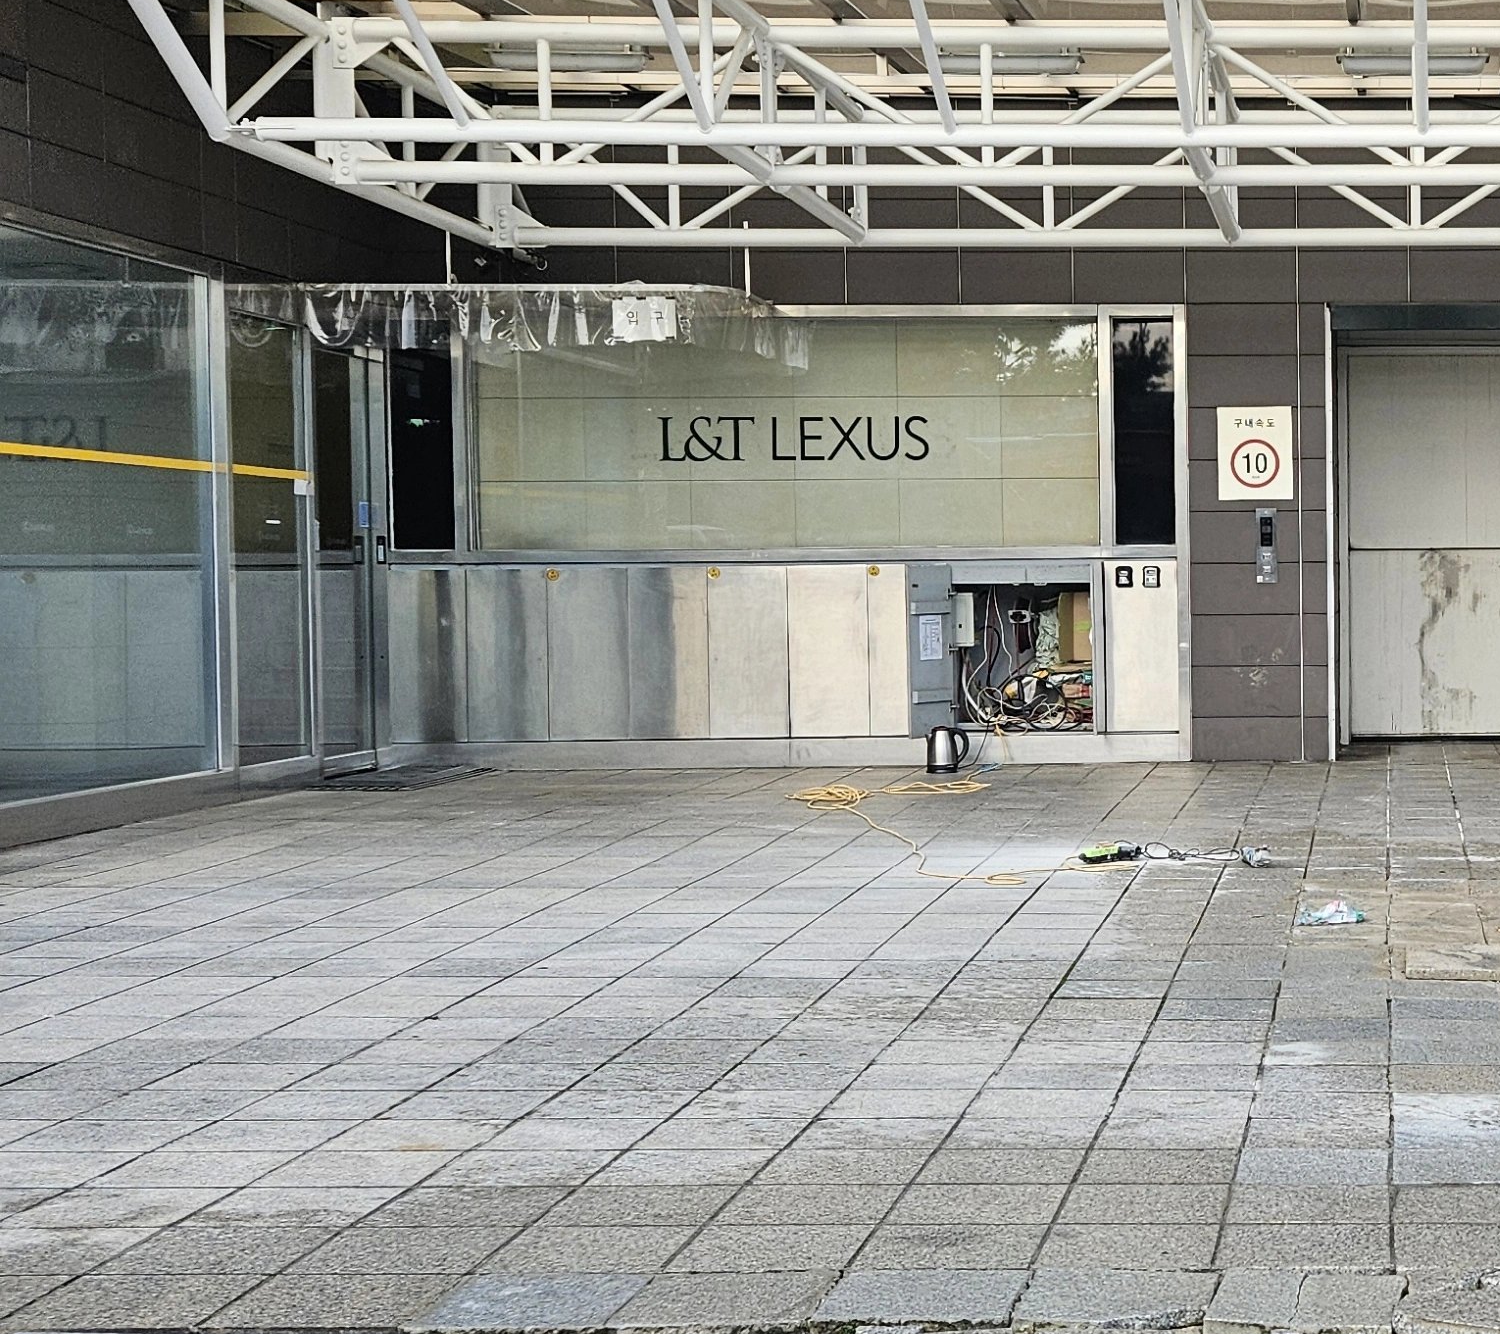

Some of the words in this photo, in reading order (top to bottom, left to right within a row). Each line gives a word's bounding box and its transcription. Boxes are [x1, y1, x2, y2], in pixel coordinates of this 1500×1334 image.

[1233, 418, 1276, 428] 구내속도
[657, 415, 755, 462] L&T
[771, 415, 930, 461] LEXUS
[1242, 452, 1268, 474] 10
